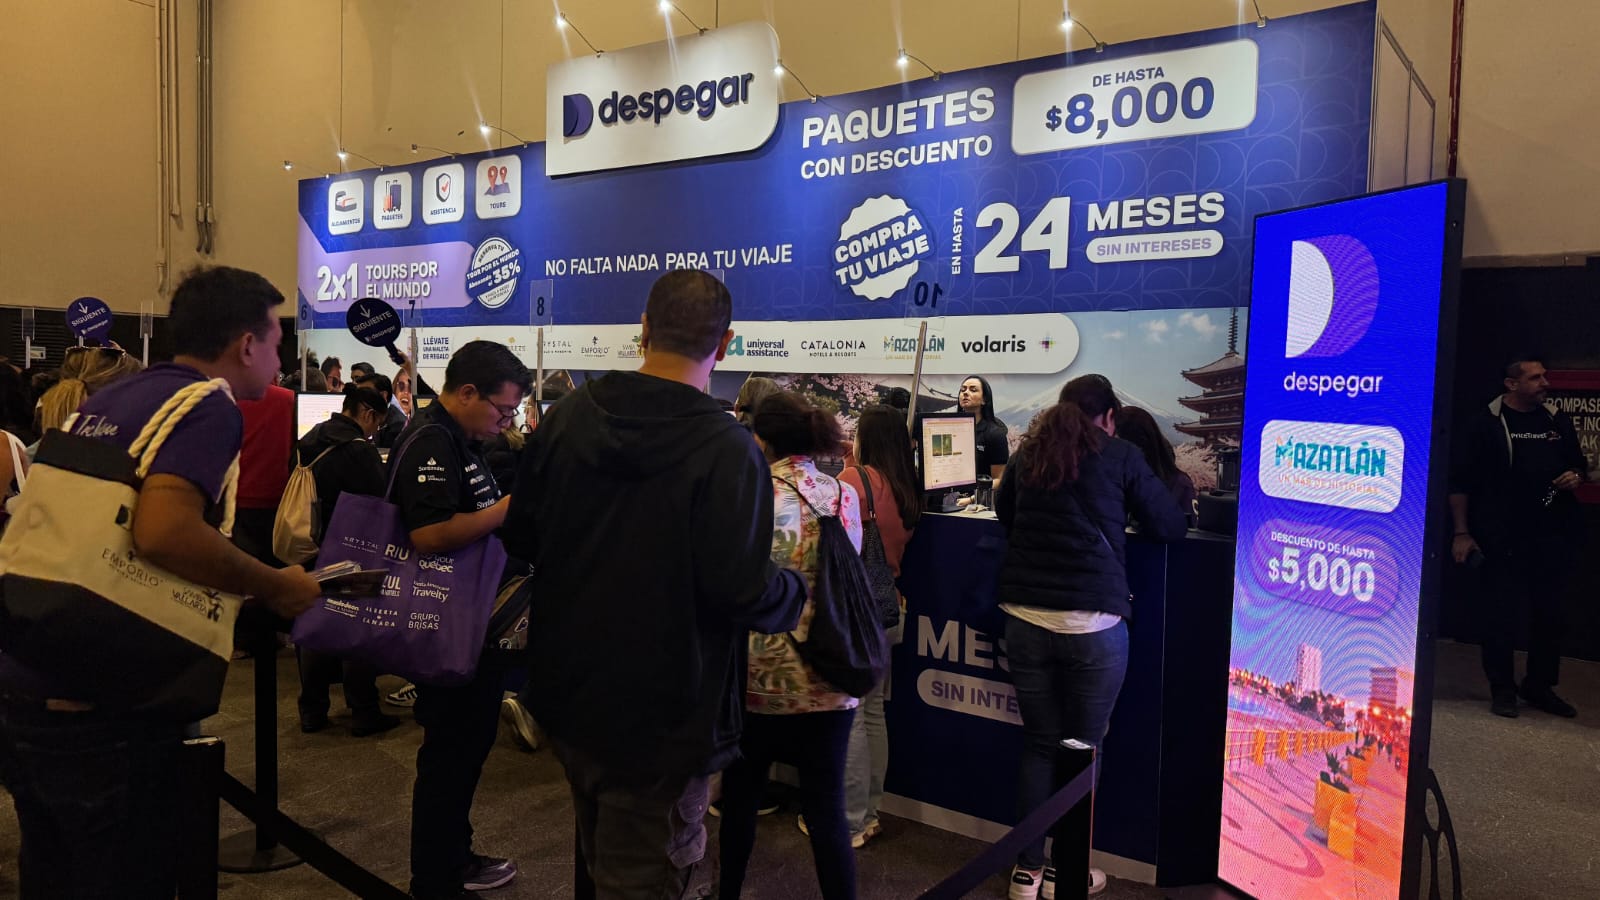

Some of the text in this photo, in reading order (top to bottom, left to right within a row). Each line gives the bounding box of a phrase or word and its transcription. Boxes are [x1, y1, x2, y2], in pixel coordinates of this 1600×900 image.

[1092, 66, 1164, 88] DE HASTA
[598, 72, 753, 124] despegar
[1045, 77, 1215, 140] $8,000
[802, 87, 995, 149] PAQUETES
[801, 134, 993, 180] CON DESCUENTO
[1087, 191, 1225, 232] MESES
[834, 214, 923, 263] COMPRA
[951, 207, 964, 275] EN HASTA
[973, 196, 1071, 274] 24
[1096, 237, 1212, 257] SIN INTERESES
[365, 261, 438, 280] TOURS POR
[545, 244, 793, 276] NO FALTA NADA PARA TU VIAJE
[835, 234, 930, 285] TU VIAJE
[316, 262, 359, 301] 2x1
[493, 259, 520, 284] 35%
[365, 281, 431, 298] EL MUNDO
[71, 307, 107, 327] SIGUIENTE
[301, 304, 308, 321] 6
[409, 300, 415, 319] 7
[536, 296, 545, 316] 8
[352, 310, 393, 333] SIGUIENTE
[423, 336, 449, 345] LLÉVATE
[746, 338, 785, 349] universal
[800, 340, 866, 350] CATALONIA
[961, 335, 1026, 353] volaris
[746, 348, 789, 358] assistance
[1283, 371, 1384, 398] despegar
[1275, 435, 1387, 478] MAZATLÁN
[384, 543, 410, 561] RIU
[1271, 531, 1375, 560] DESCUENTO DE HASTA
[101, 548, 160, 587] EMPORIO
[1268, 546, 1375, 602] $5,000
[412, 586, 449, 603] Travelty
[408, 621, 440, 630] BRISAS
[410, 612, 440, 622] GRUPO
[931, 680, 965, 702] SIN
